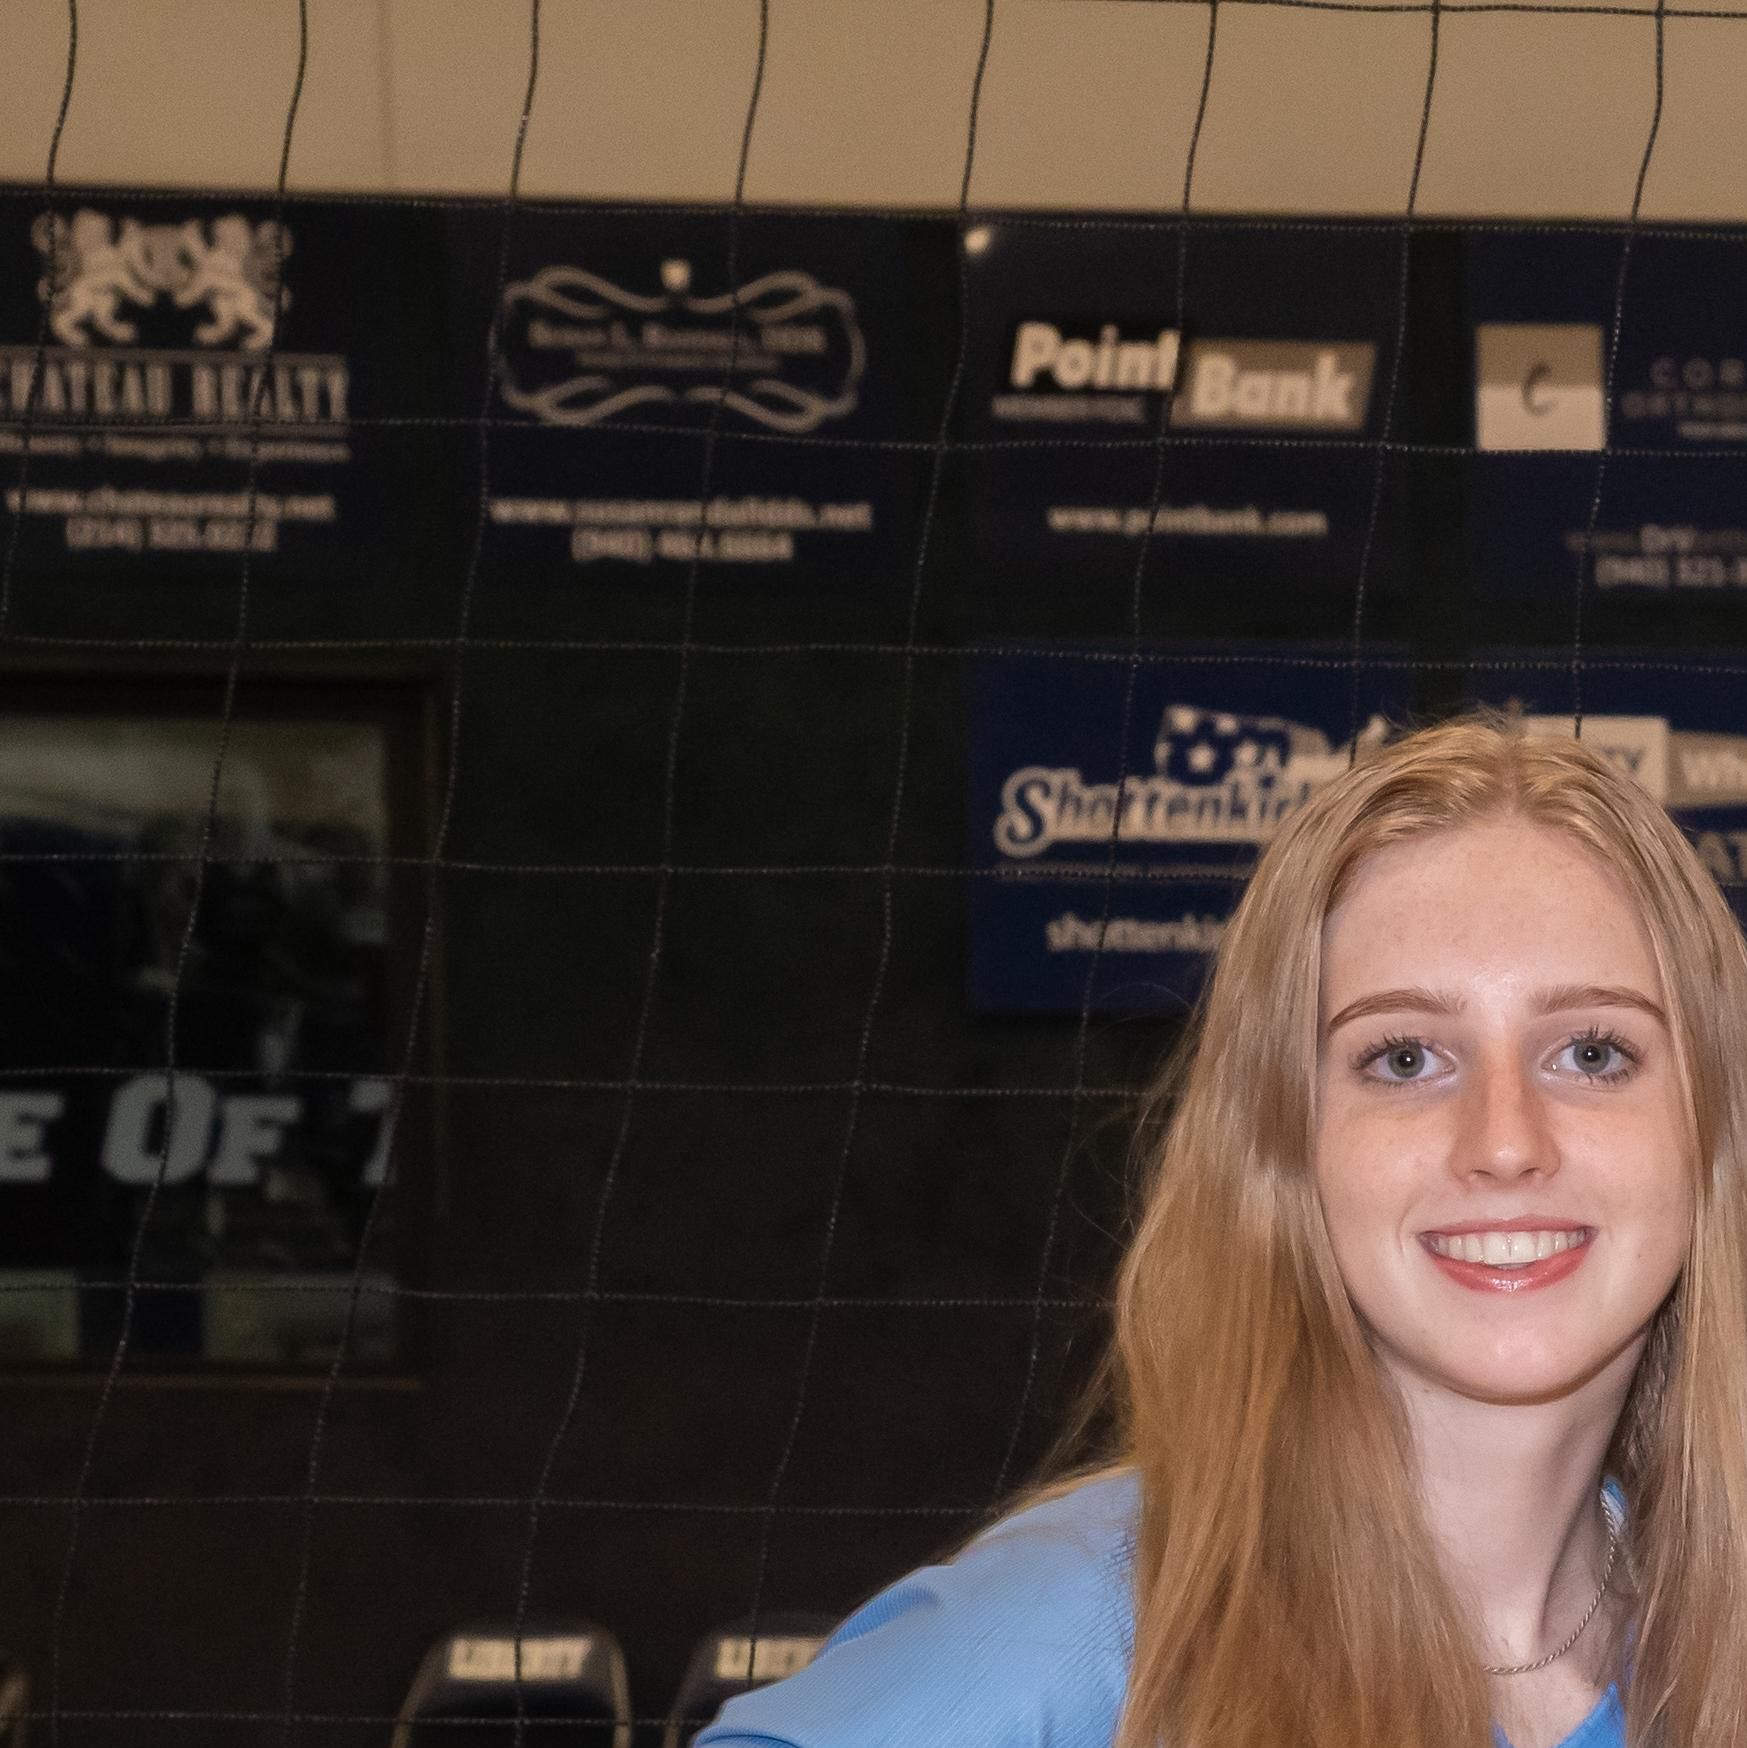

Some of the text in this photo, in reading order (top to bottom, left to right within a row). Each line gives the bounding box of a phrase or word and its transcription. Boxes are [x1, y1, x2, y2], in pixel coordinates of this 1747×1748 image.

[1010, 321, 1181, 391] Point
[1191, 352, 1354, 420] Bank
[101, 1073, 303, 1187] OF
